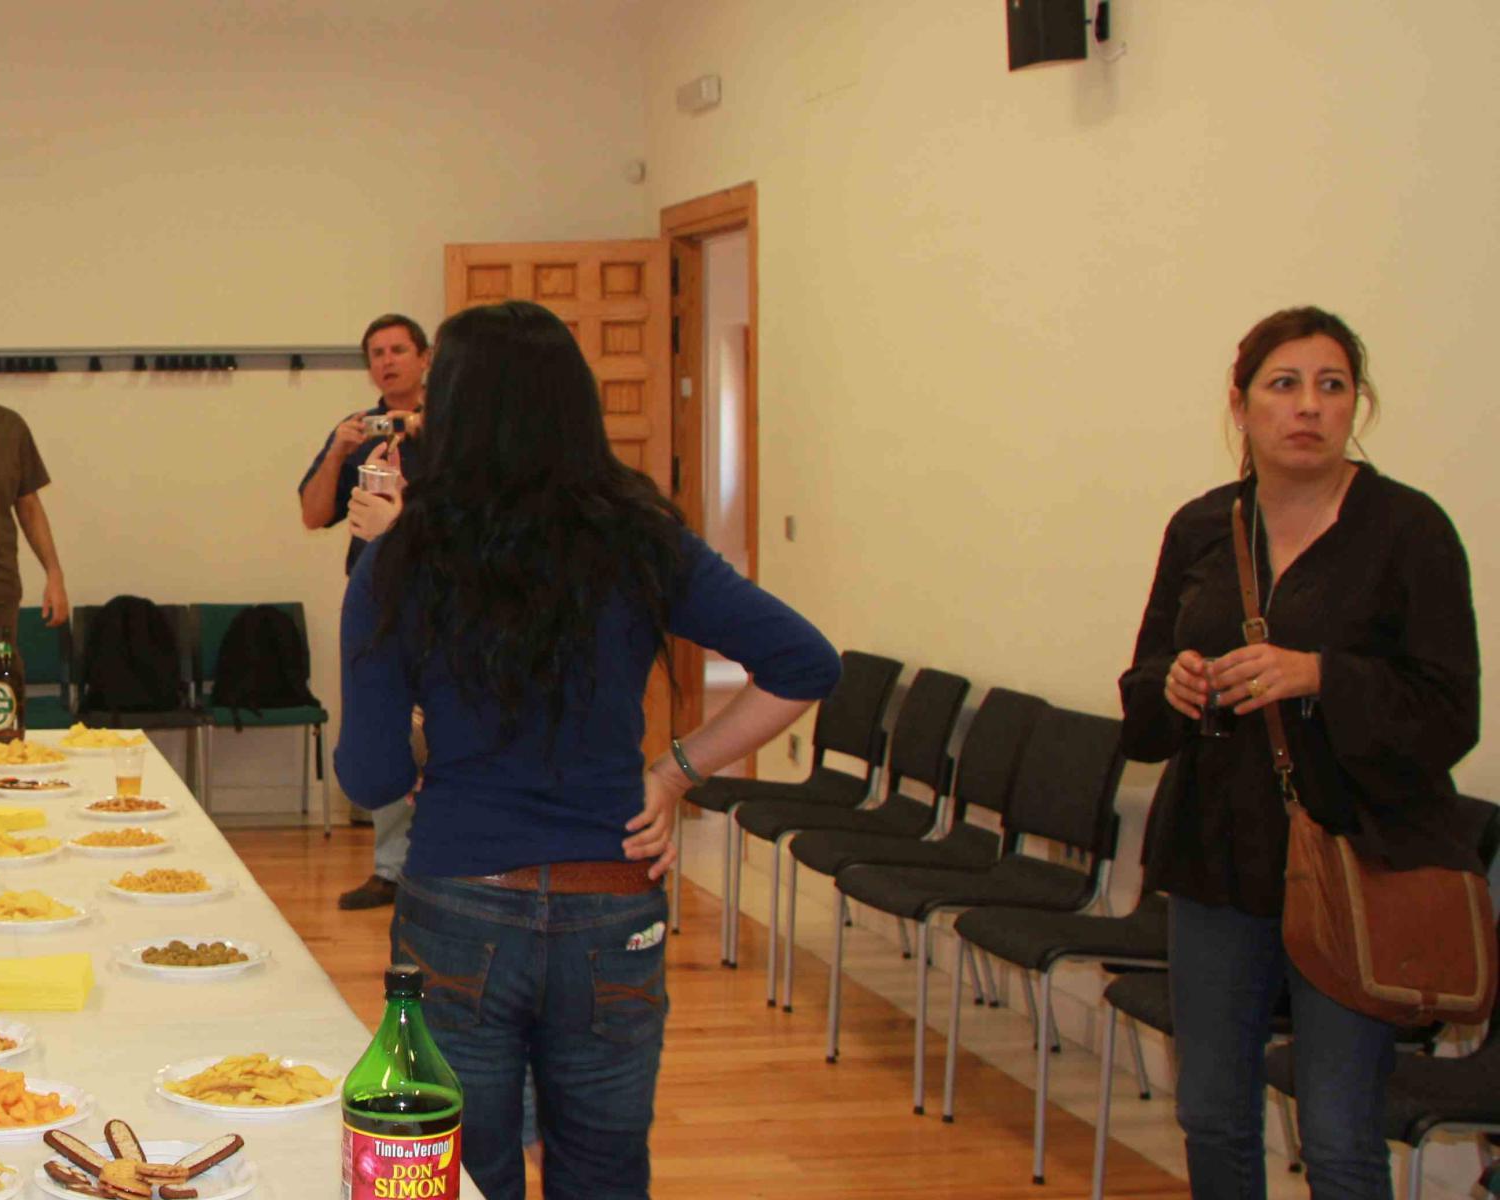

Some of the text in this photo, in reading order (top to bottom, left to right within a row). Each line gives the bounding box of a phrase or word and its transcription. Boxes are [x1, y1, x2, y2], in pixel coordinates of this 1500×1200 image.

[375, 1141, 404, 1158] Tinto
[413, 1140, 449, 1158] Verano
[393, 1163, 433, 1180] DON
[374, 1175, 446, 1199] SIMON
